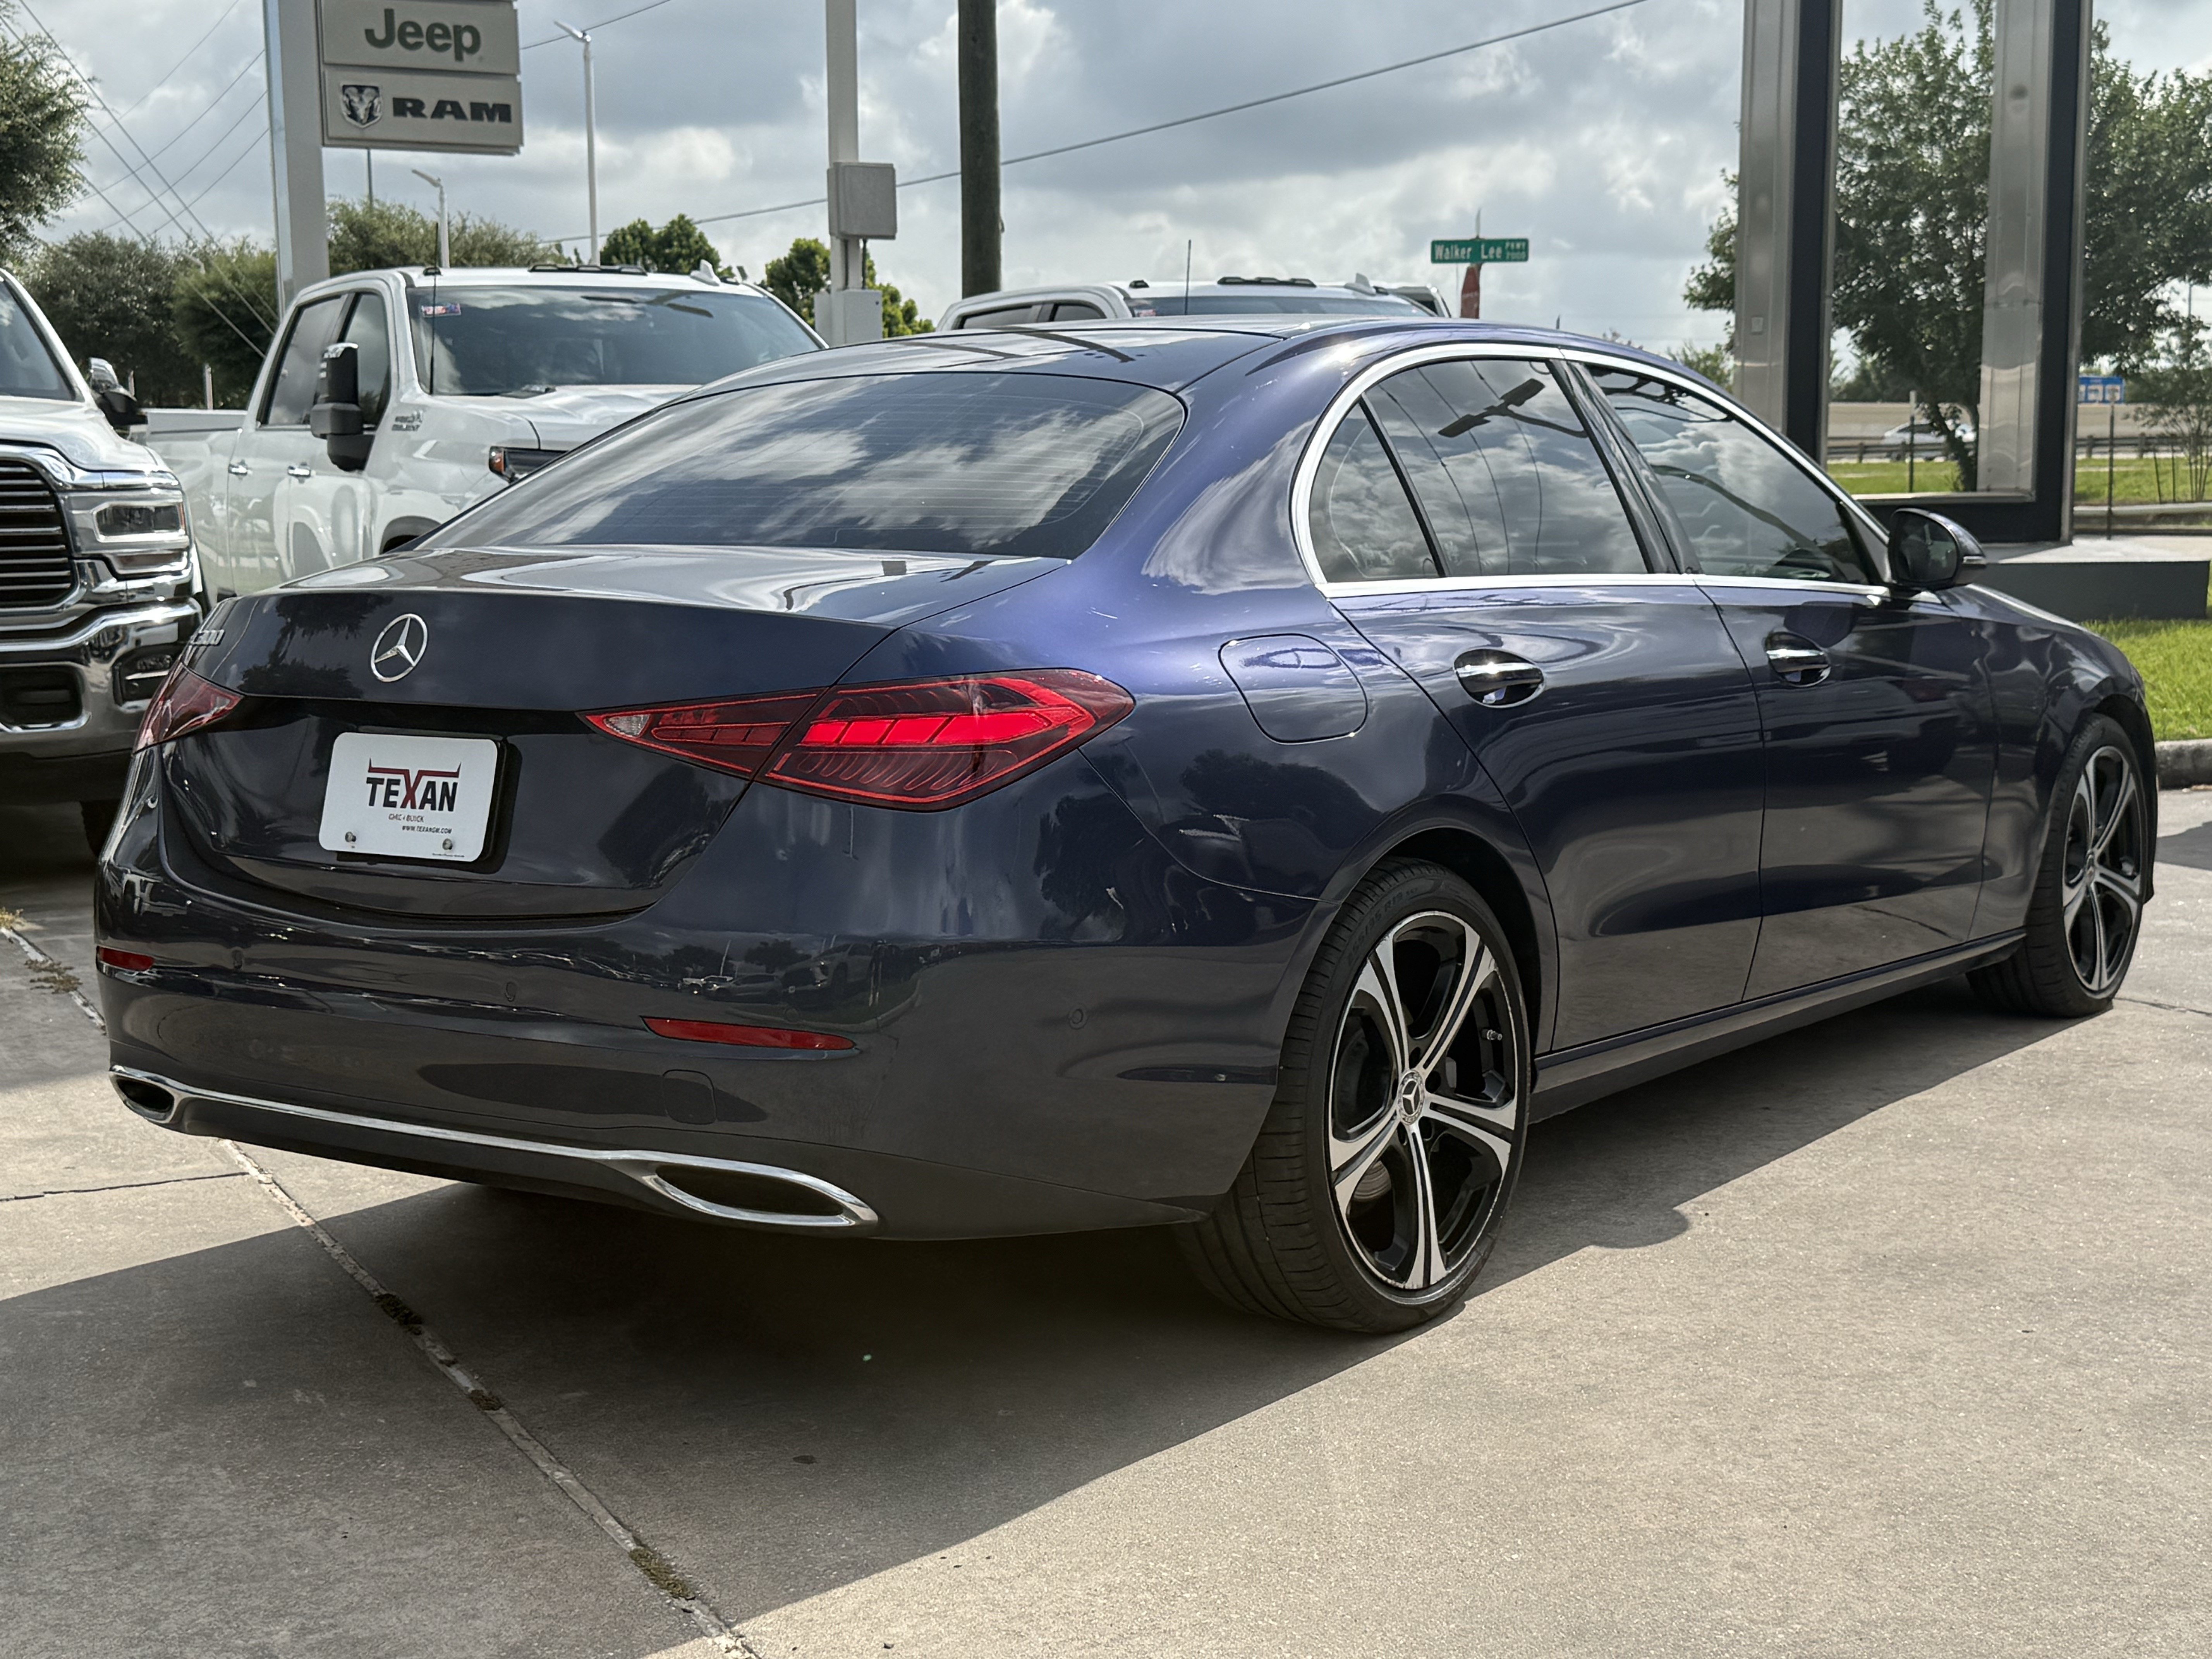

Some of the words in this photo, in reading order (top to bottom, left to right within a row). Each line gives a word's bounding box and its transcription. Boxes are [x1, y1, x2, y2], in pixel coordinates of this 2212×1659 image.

[364, 8, 481, 62] Jeep
[392, 97, 512, 124] RAM
[1434, 244, 1472, 260] Walker
[1480, 244, 1503, 259] Lee
[366, 767, 460, 812] TEXAN
